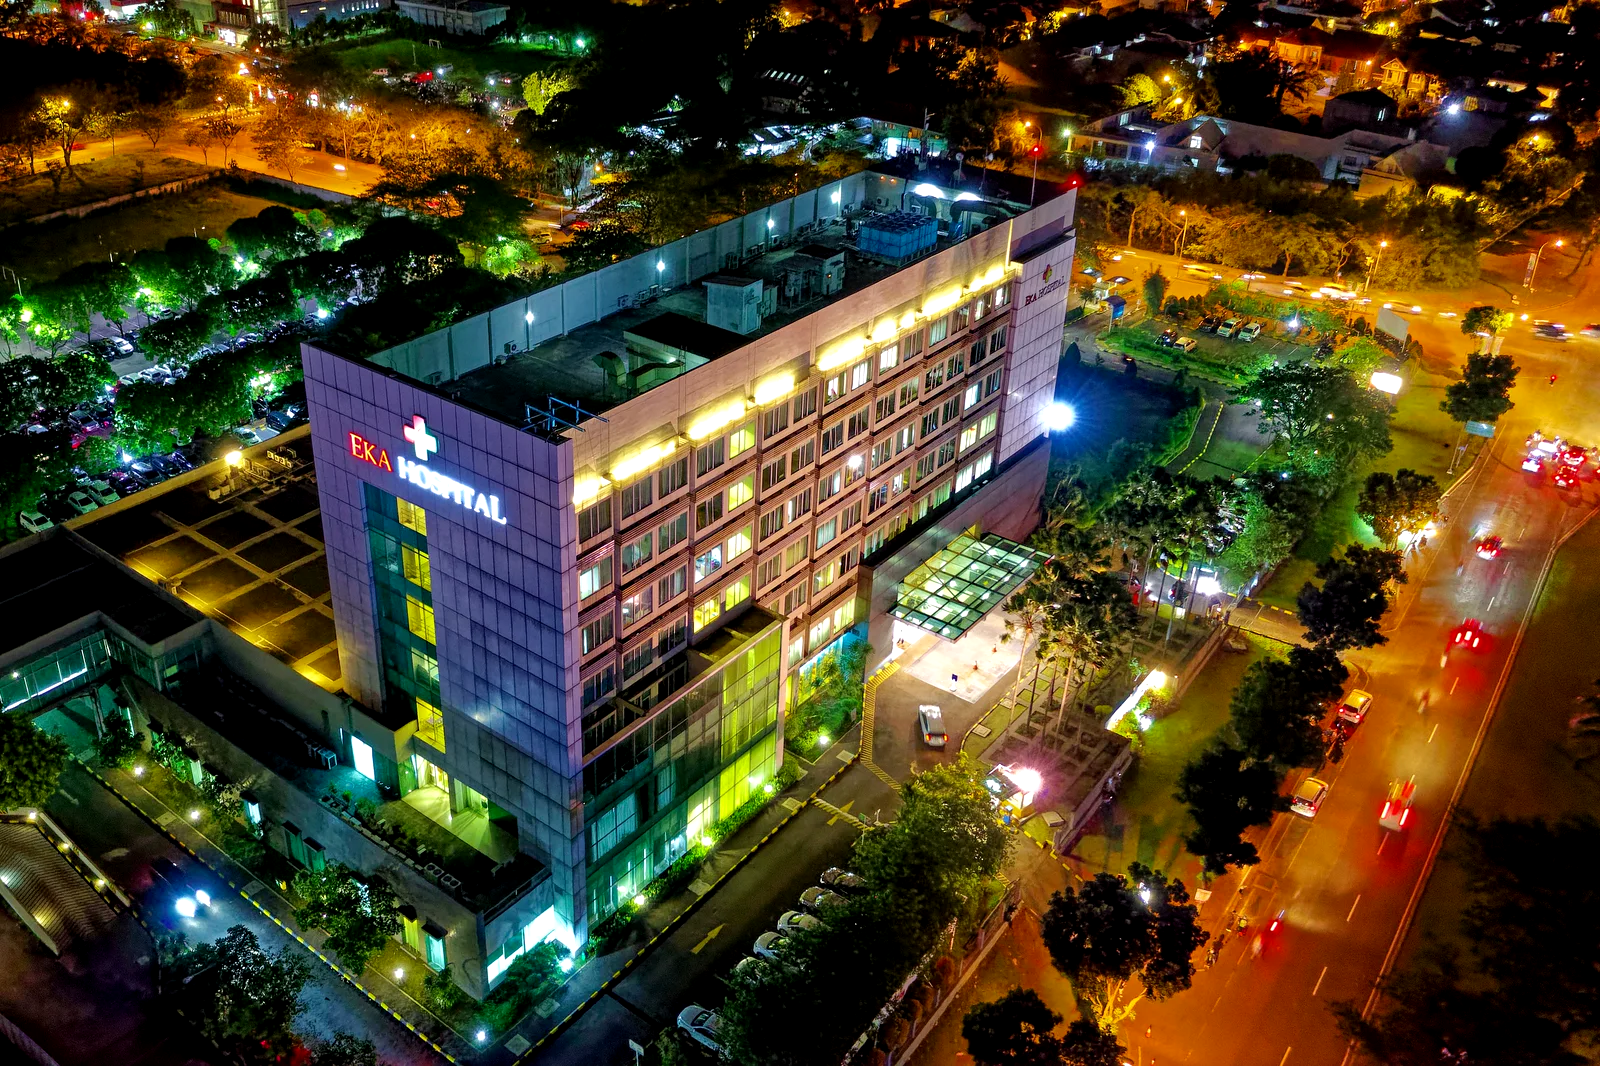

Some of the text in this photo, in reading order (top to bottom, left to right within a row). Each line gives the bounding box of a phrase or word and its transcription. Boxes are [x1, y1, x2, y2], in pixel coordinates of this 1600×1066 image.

[1025, 276, 1066, 306] EKA HOSPITAL
[349, 431, 508, 525] EKA HOSPITAL
